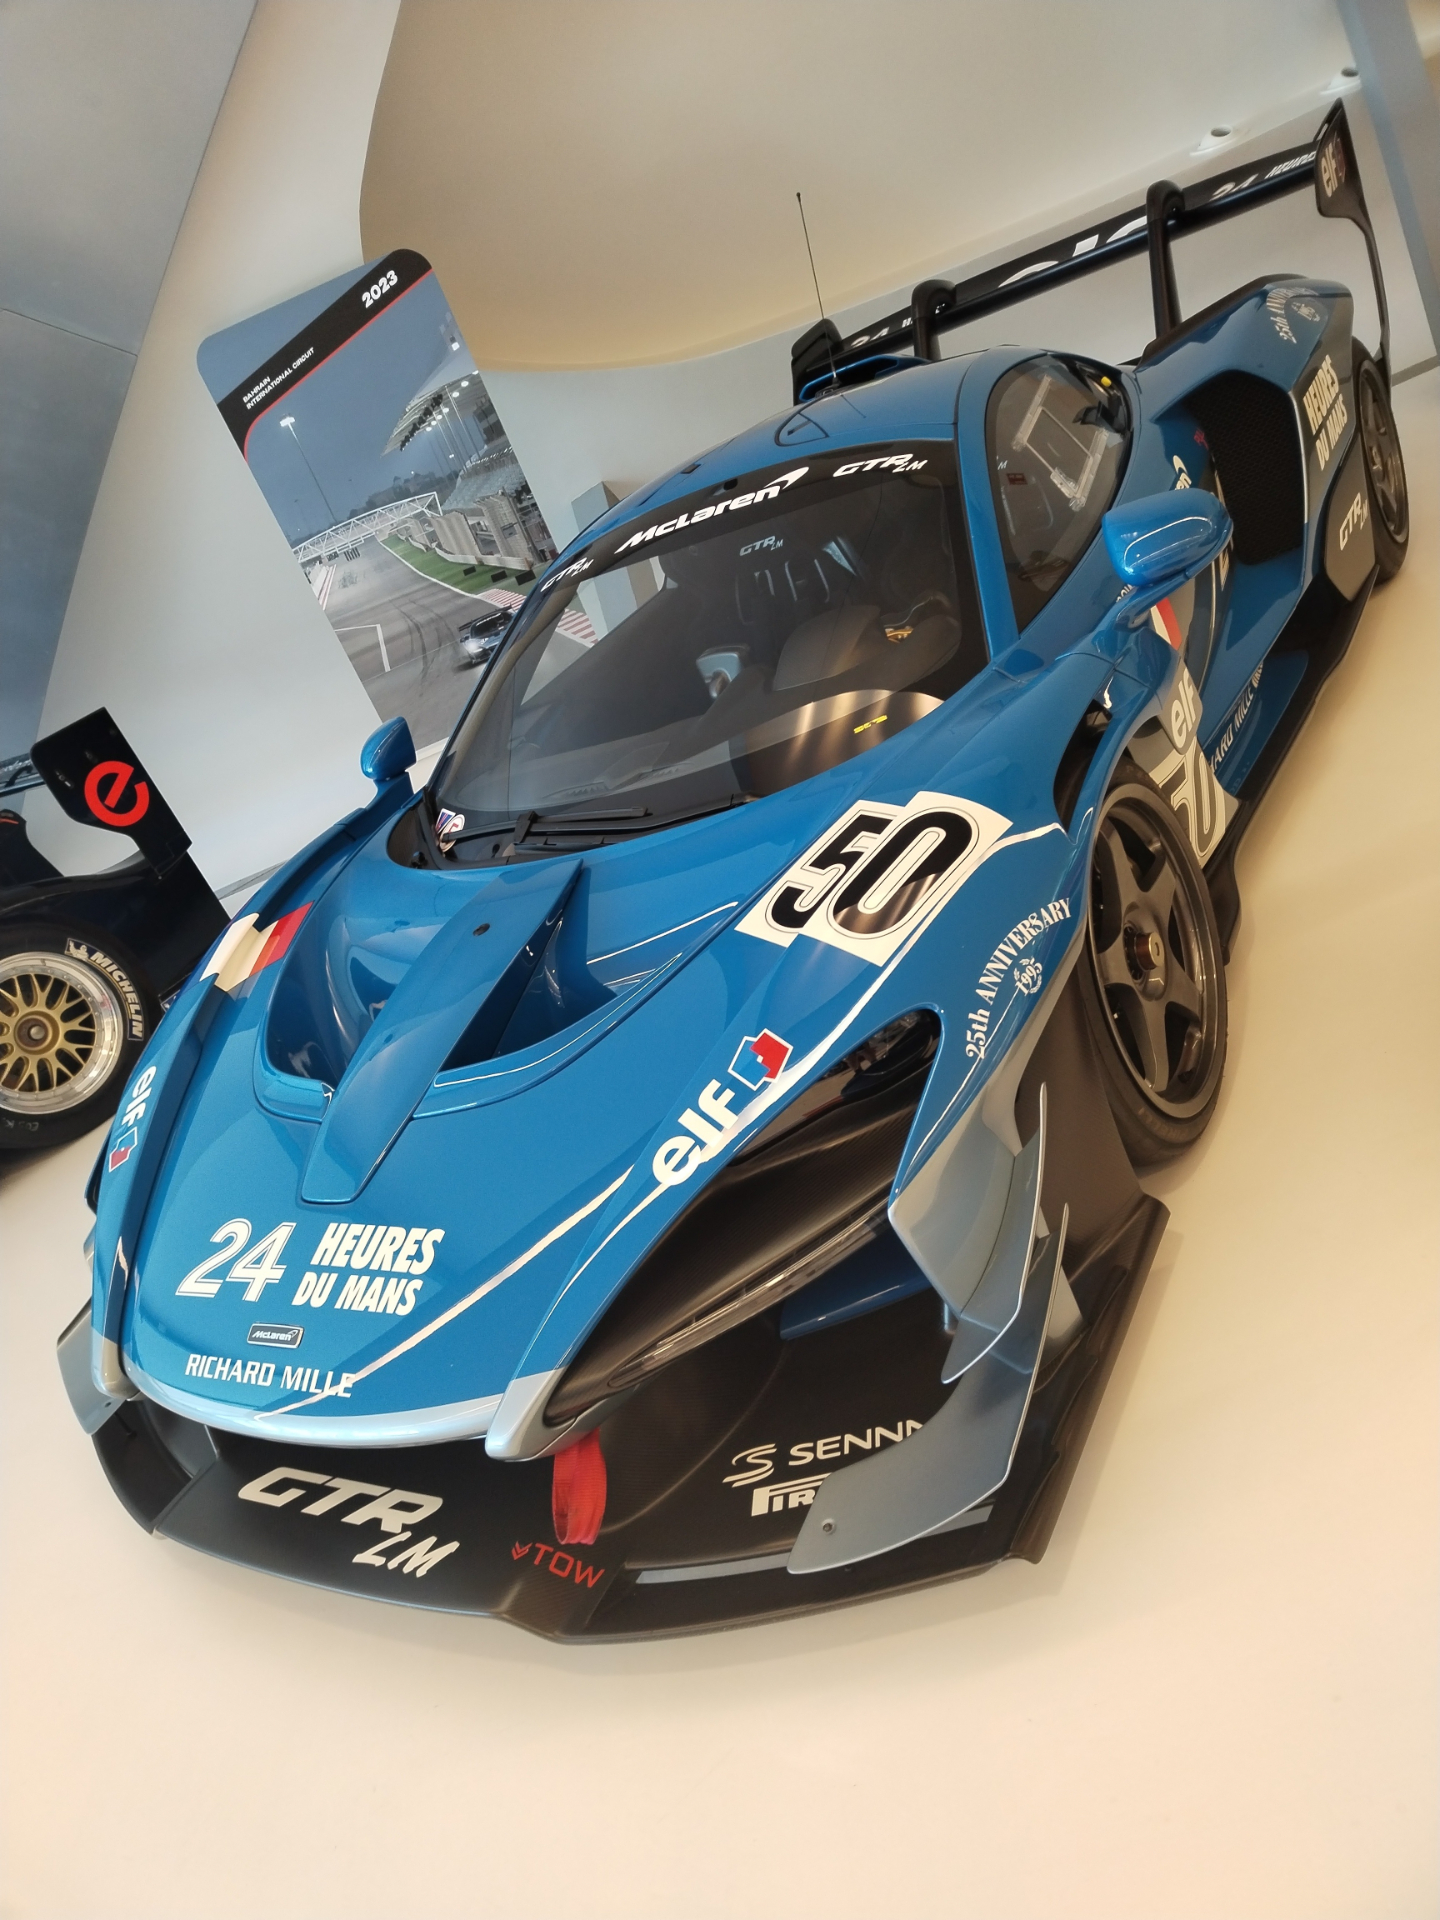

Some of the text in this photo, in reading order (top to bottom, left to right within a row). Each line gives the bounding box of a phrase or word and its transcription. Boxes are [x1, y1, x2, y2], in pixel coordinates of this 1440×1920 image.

[1320, 142, 1338, 198] elf
[361, 270, 398, 309] 2023
[242, 376, 271, 403] BAHRAIN
[246, 346, 314, 410] INTERNATIONAL CIRCUIT
[1303, 354, 1340, 436] HEURES
[1315, 393, 1347, 471] DU MANS
[832, 453, 914, 477] GTR
[613, 484, 783, 555] McLaren
[739, 535, 776, 557] GTR
[1339, 492, 1362, 551] GTR
[540, 557, 588, 592] GTR
[1171, 666, 1196, 749] elf
[765, 807, 979, 940] 50
[90, 951, 144, 1039] MICHELIN
[965, 898, 1072, 1060] 25th ANNIVERSARY
[1014, 956, 1043, 997] 1995
[122, 1065, 157, 1127] elf
[652, 1078, 738, 1186] elf
[175, 1217, 446, 1303] 24 HEURES
[291, 1271, 424, 1316] DU MANS
[252, 1330, 294, 1341] McLaren
[185, 1354, 357, 1398] RICHARD MILLE
[237, 1466, 460, 1578] GTR LM
[528, 1542, 606, 1588] TOW
